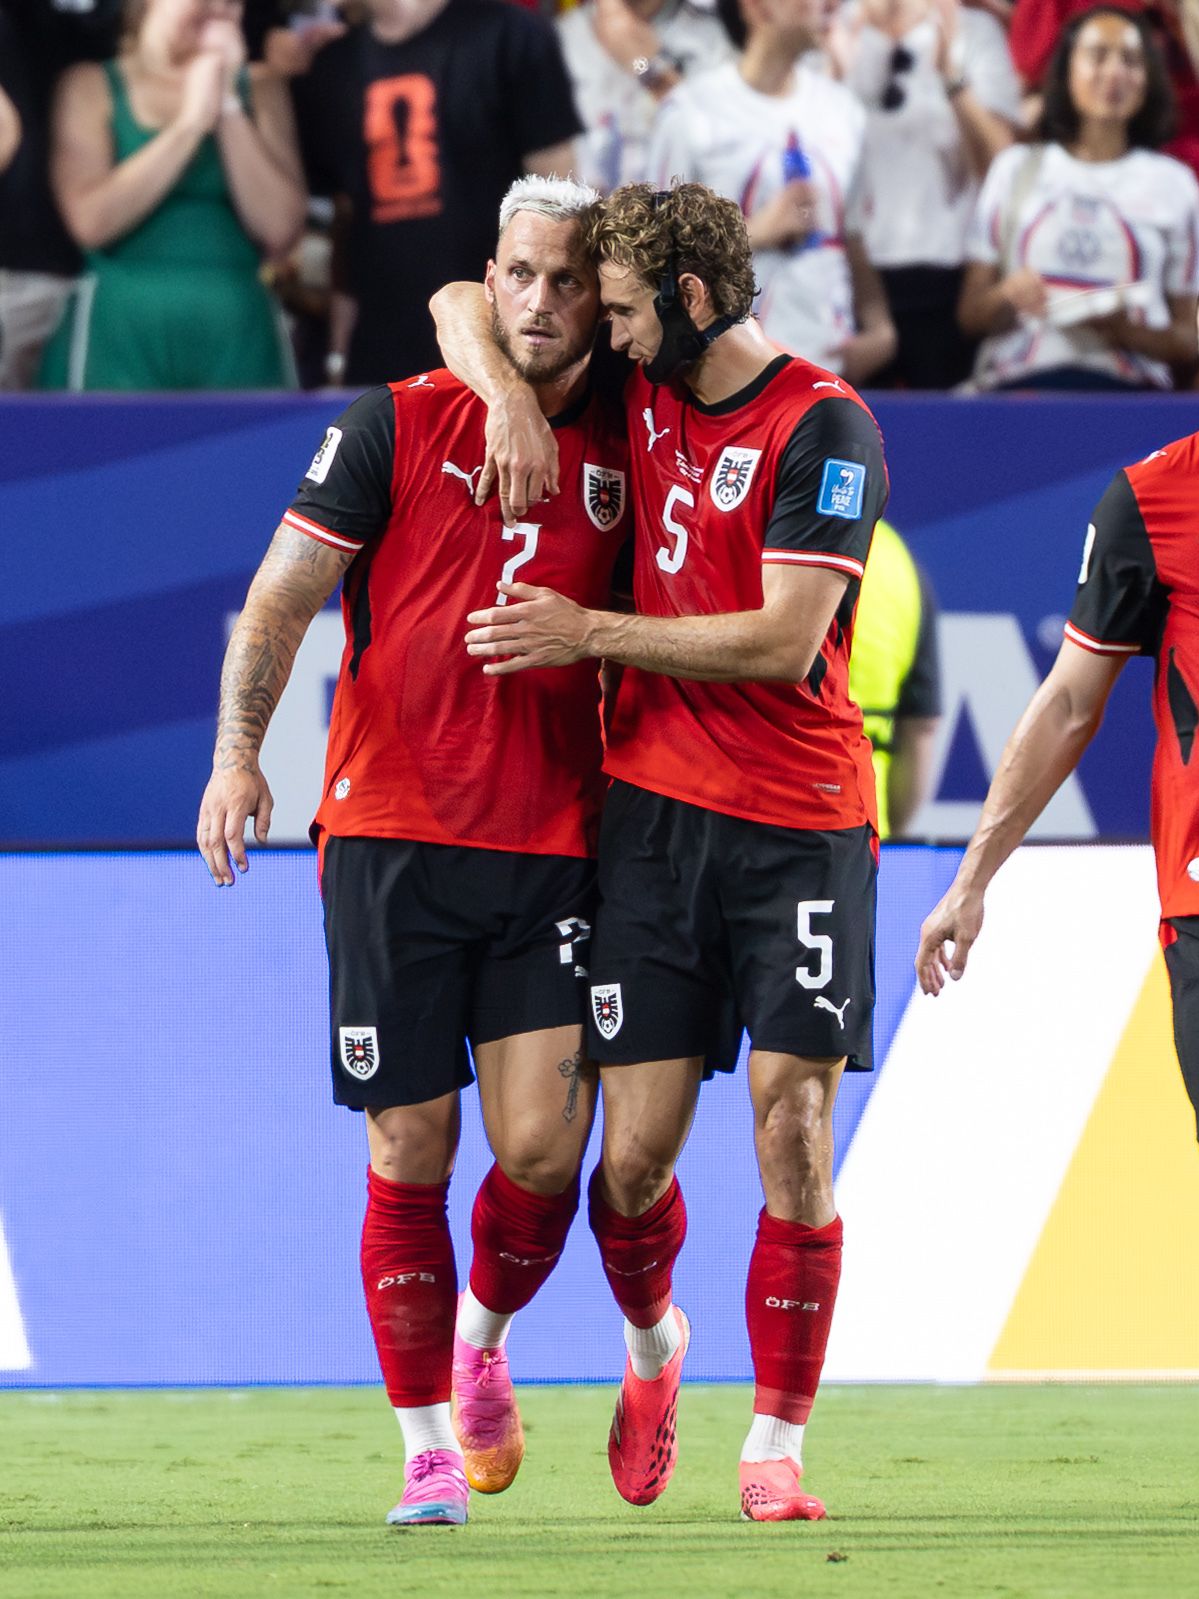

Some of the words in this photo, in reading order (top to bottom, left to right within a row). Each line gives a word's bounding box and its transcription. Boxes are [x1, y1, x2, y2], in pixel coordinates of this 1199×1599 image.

[496, 522, 542, 606] 7
[656, 482, 695, 575] 5
[796, 899, 836, 990] 5
[377, 1272, 436, 1290] ÖFB
[764, 1296, 821, 1311] ÖFB
